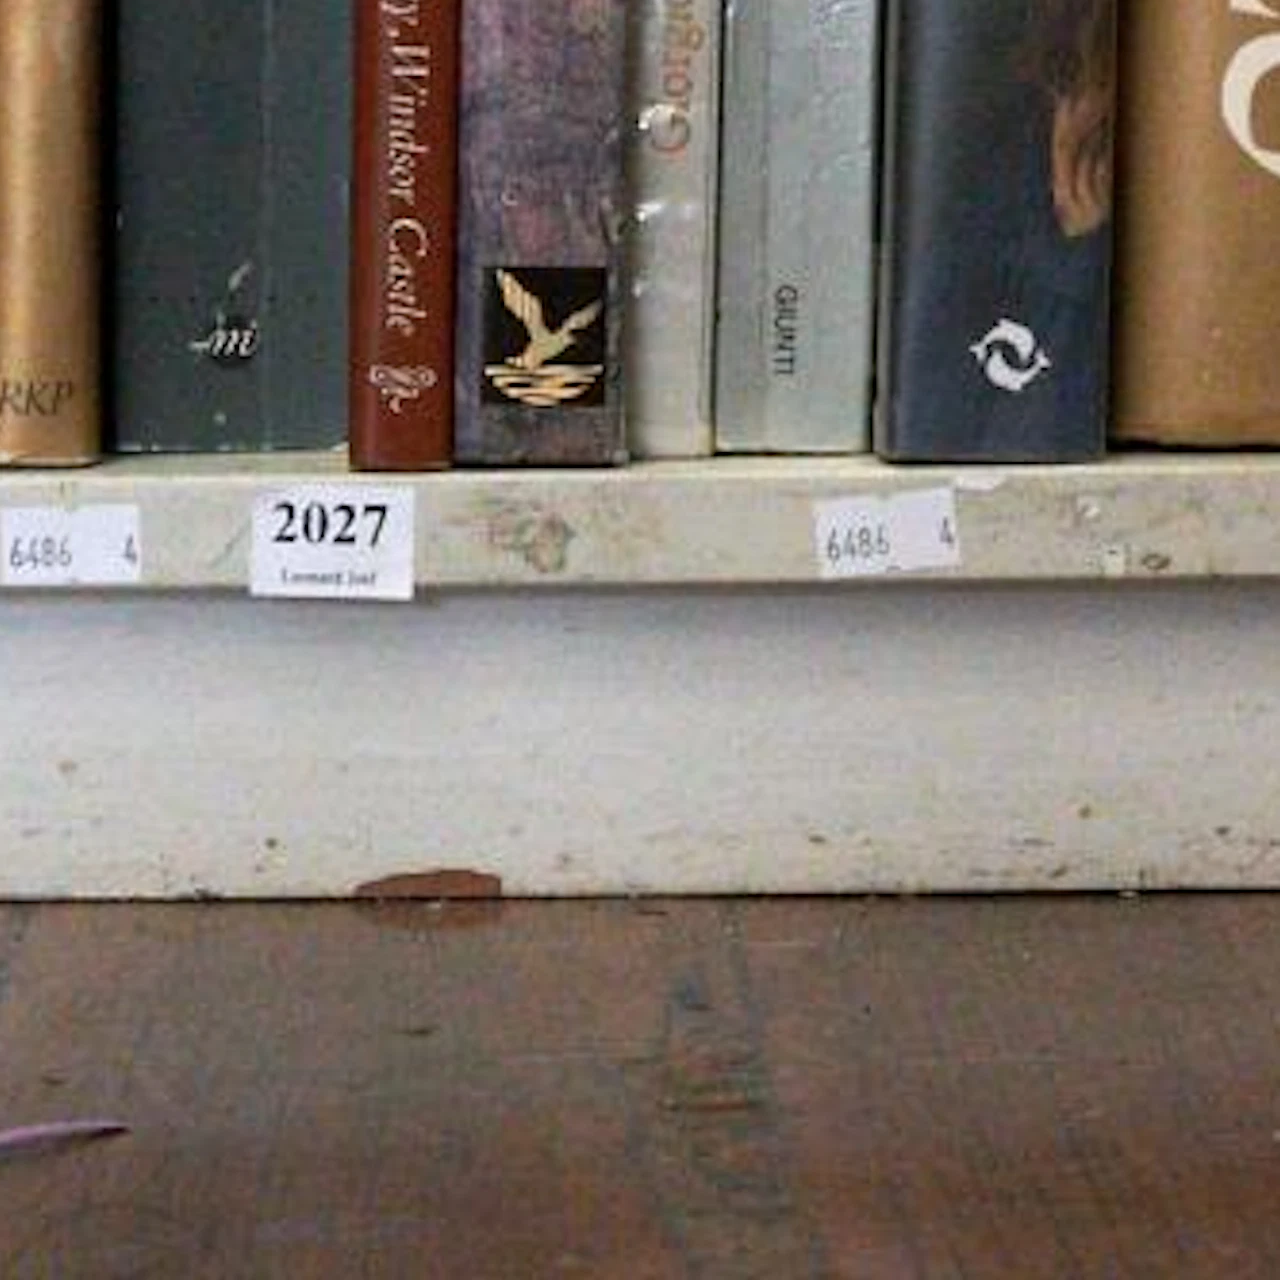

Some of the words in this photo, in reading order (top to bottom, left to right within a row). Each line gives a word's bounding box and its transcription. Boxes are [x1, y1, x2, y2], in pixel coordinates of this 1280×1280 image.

[387, 41, 432, 205] Windsor
[385, 217, 428, 336] Castle
[773, 285, 798, 376] GIUNTI
[273, 500, 389, 549] 2027
